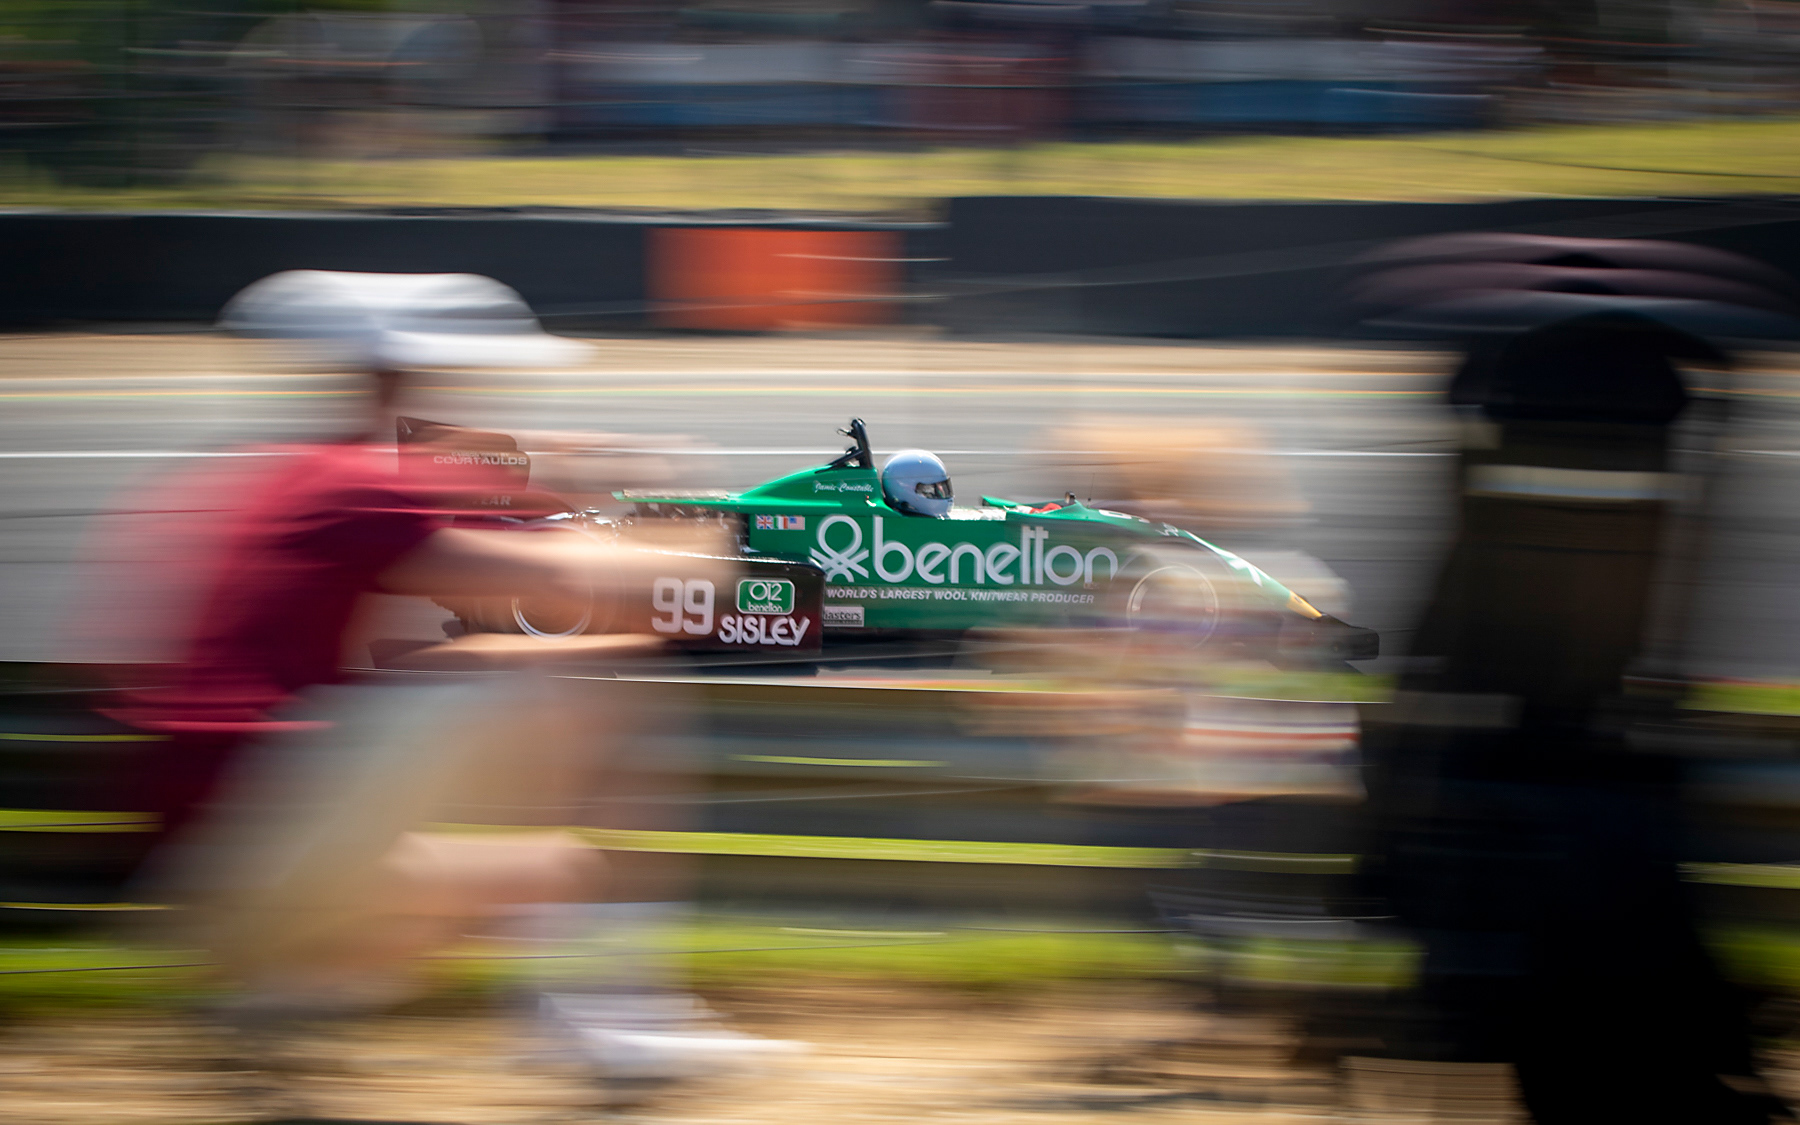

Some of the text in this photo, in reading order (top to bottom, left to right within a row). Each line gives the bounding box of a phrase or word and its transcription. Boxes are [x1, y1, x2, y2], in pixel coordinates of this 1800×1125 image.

[433, 455, 528, 465] COURTAULDS
[814, 482, 874, 493] Jamie Constable
[872, 514, 1119, 586] benetton
[651, 576, 716, 636] 99
[826, 588, 1096, 604] WORLD'S LARGEST WOOL KNITWEAR PRODUCER
[718, 613, 811, 647] SISLEY
